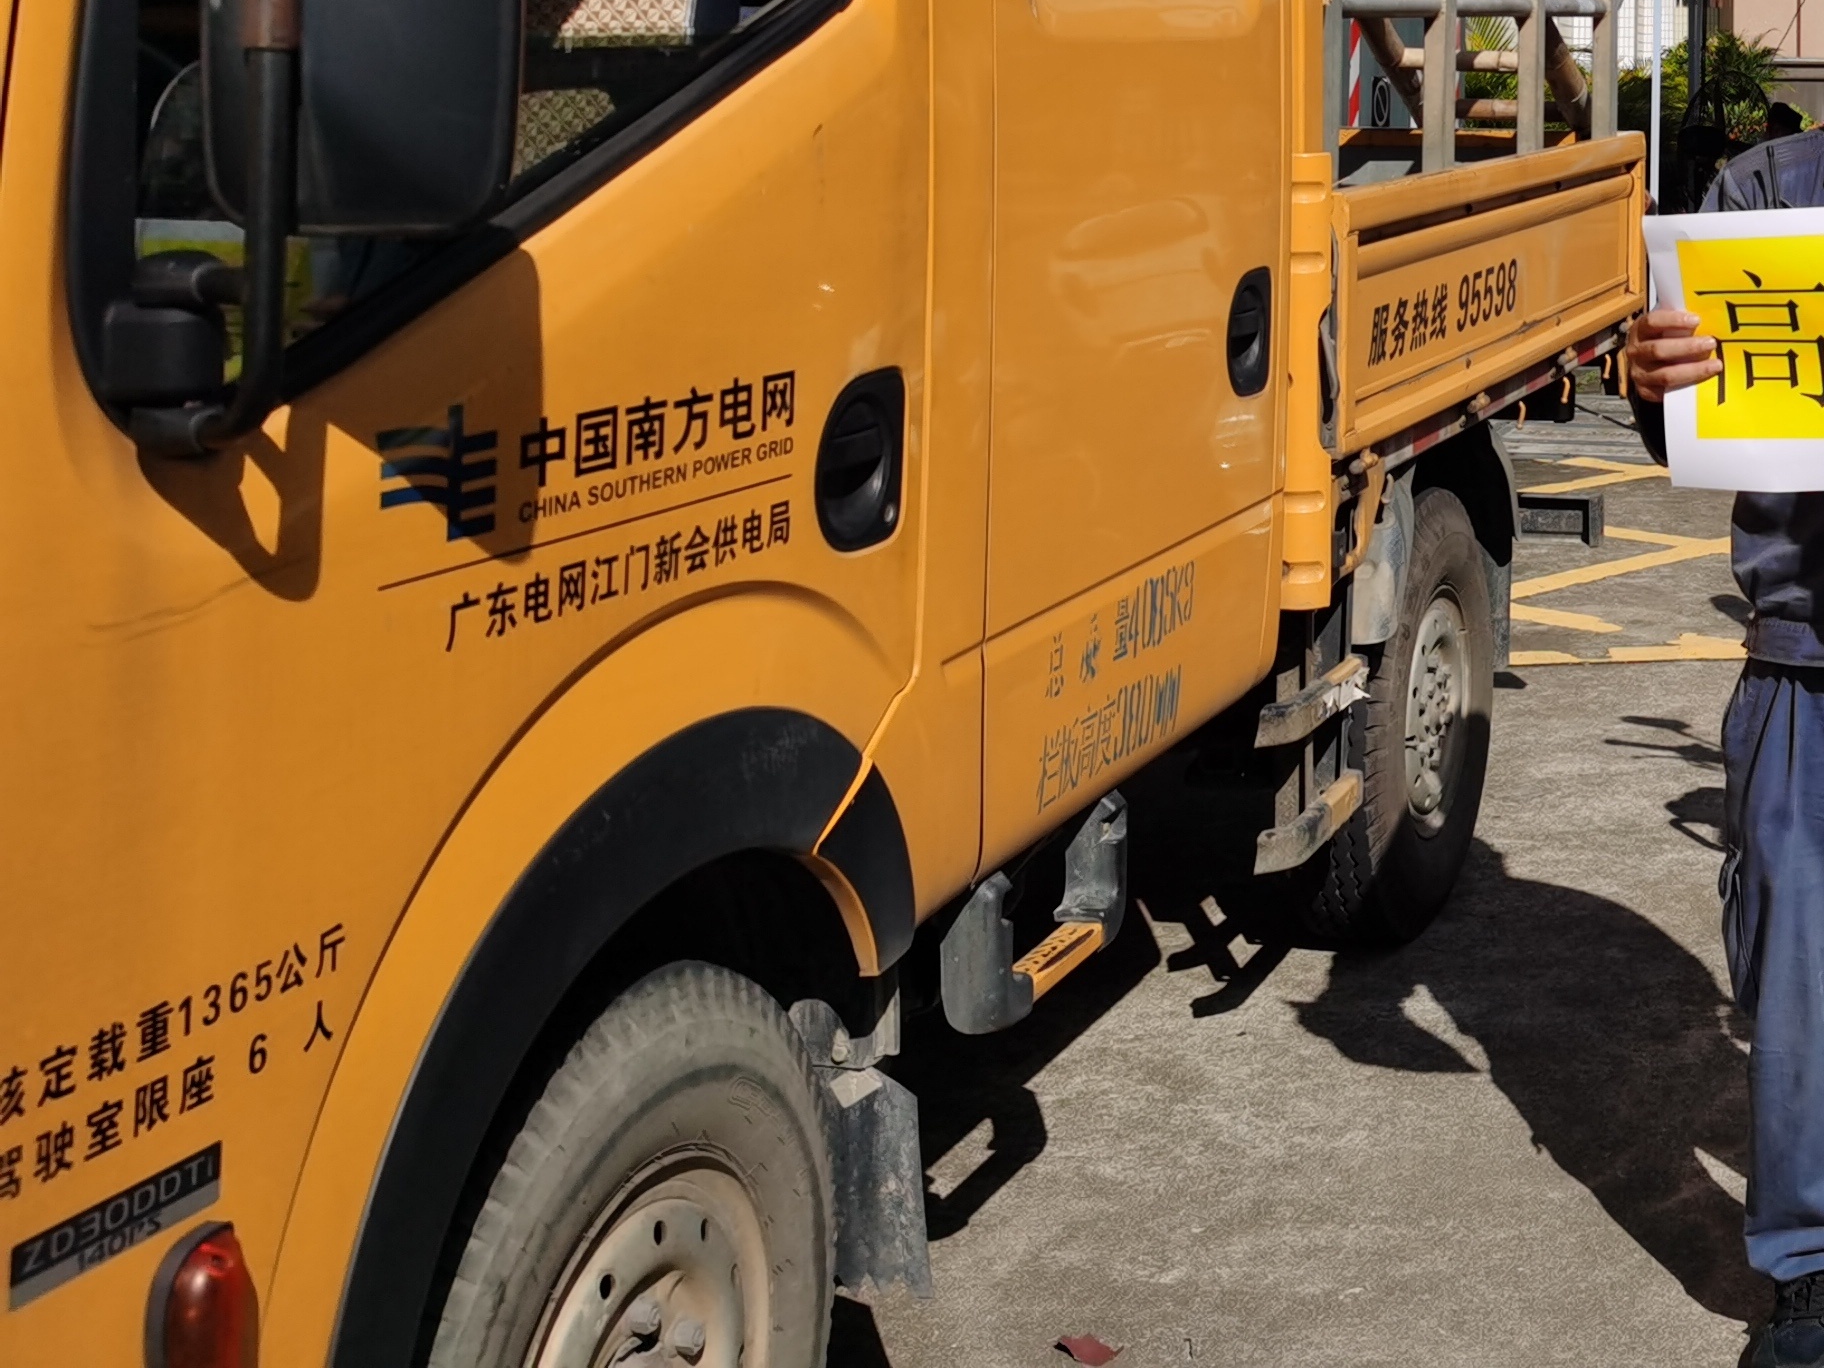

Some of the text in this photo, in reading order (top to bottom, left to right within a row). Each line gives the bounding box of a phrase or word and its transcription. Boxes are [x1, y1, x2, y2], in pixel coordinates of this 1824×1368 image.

[1367, 257, 1518, 369] 服务热线 95598
[517, 435, 795, 524] CHINA SOUTHERN POWER GRID
[519, 369, 797, 488] 中国南方电网
[445, 499, 792, 653] 广东电网江门新会供电局
